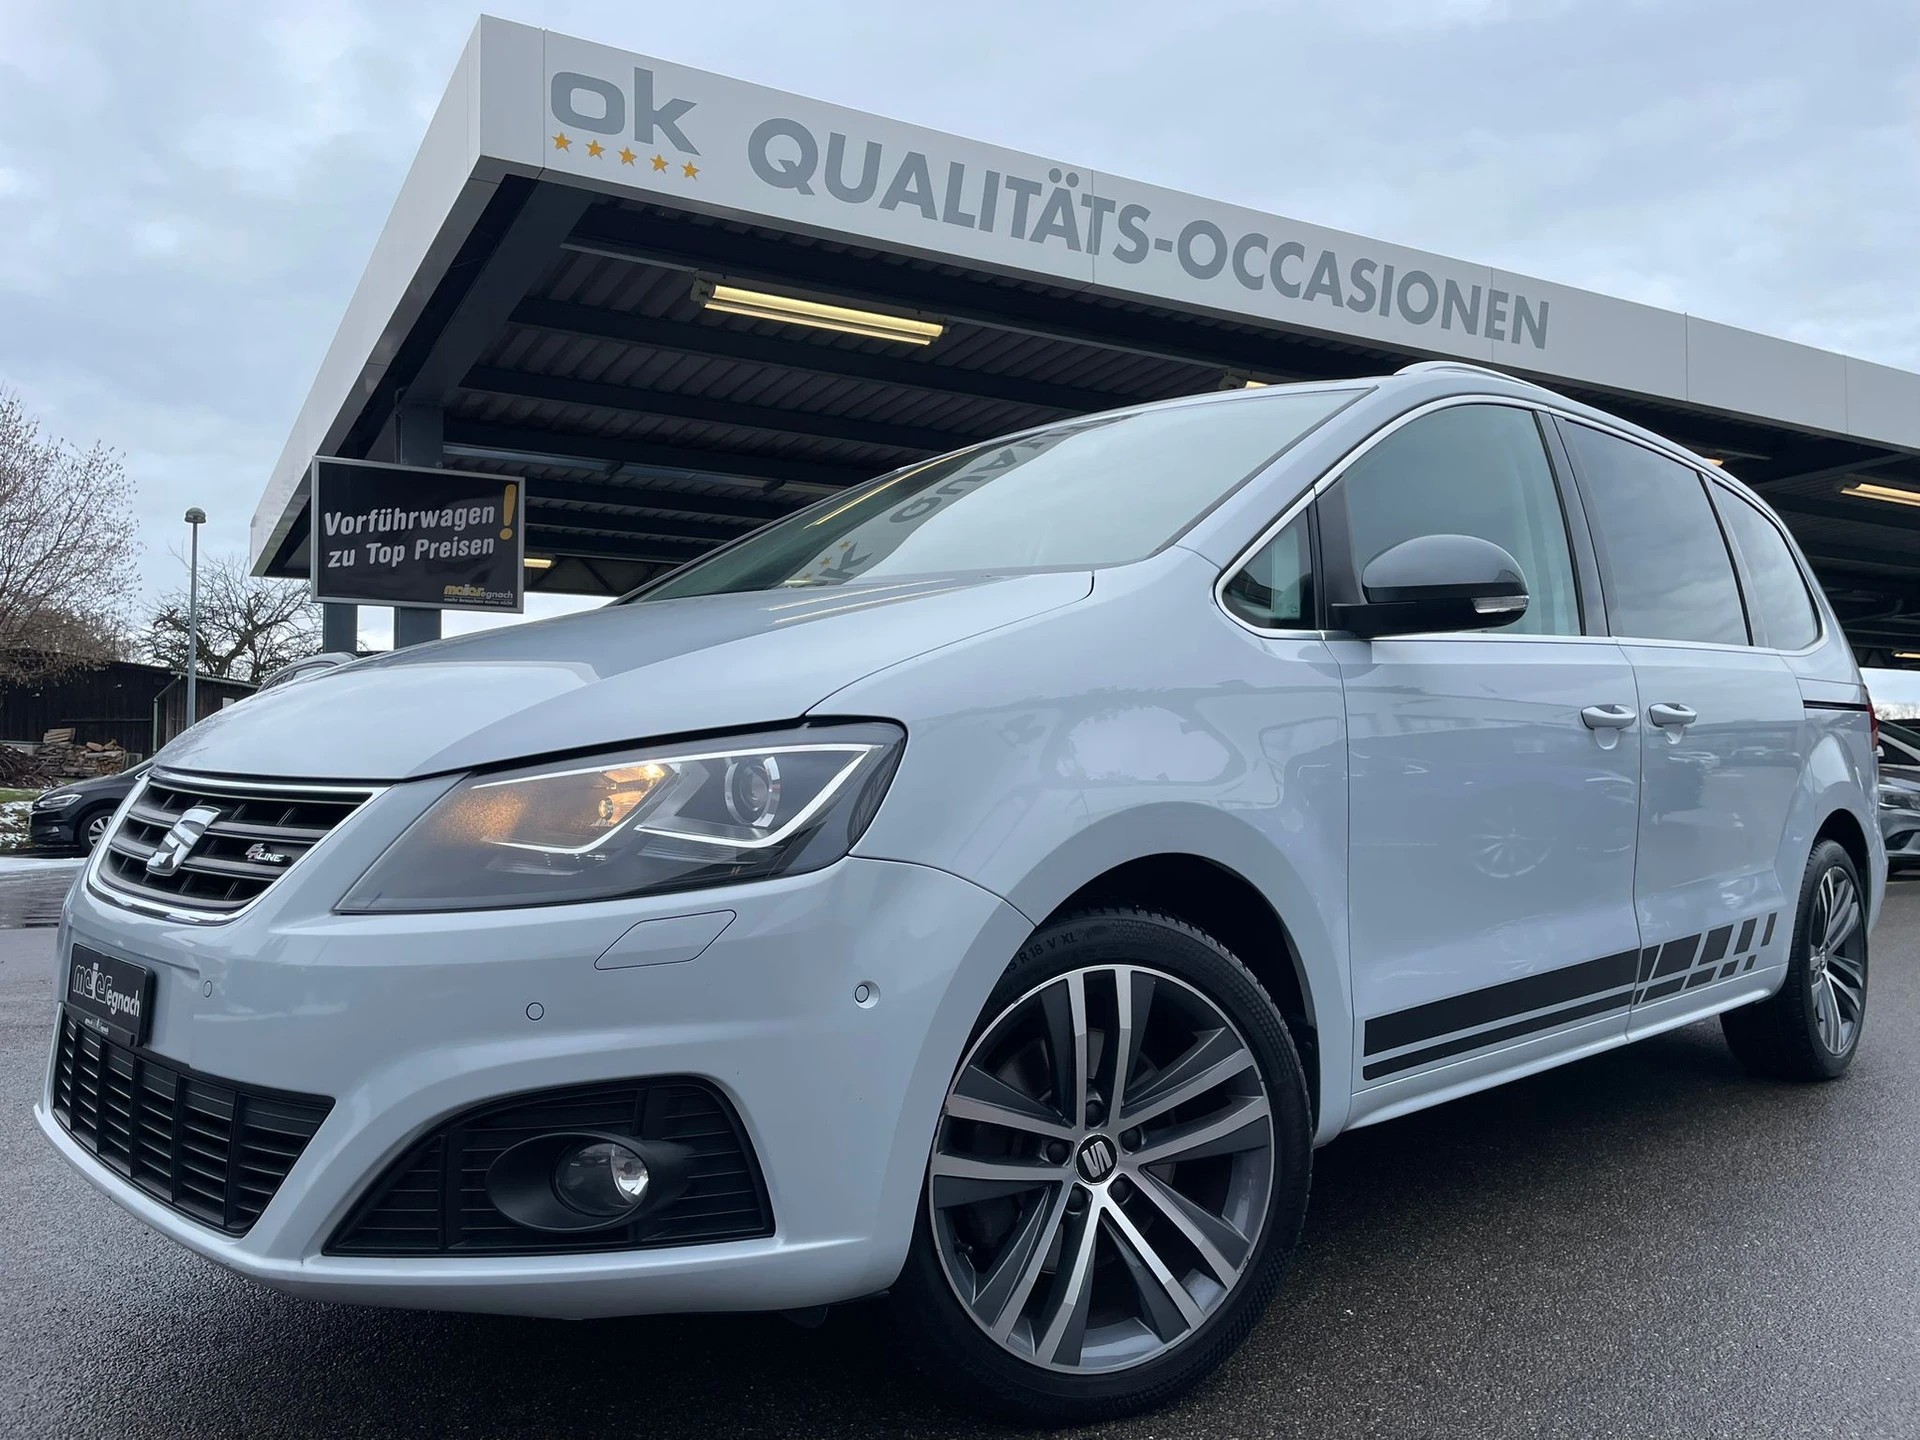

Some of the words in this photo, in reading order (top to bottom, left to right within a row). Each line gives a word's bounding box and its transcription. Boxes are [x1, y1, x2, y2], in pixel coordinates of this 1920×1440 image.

[551, 67, 700, 155] ok
[748, 117, 1550, 349] QUALITÄTS-OCCASIONEN
[324, 505, 495, 536] Vorführwagen
[327, 549, 355, 568] zu
[366, 543, 405, 567] Top
[415, 537, 495, 560] Preisen
